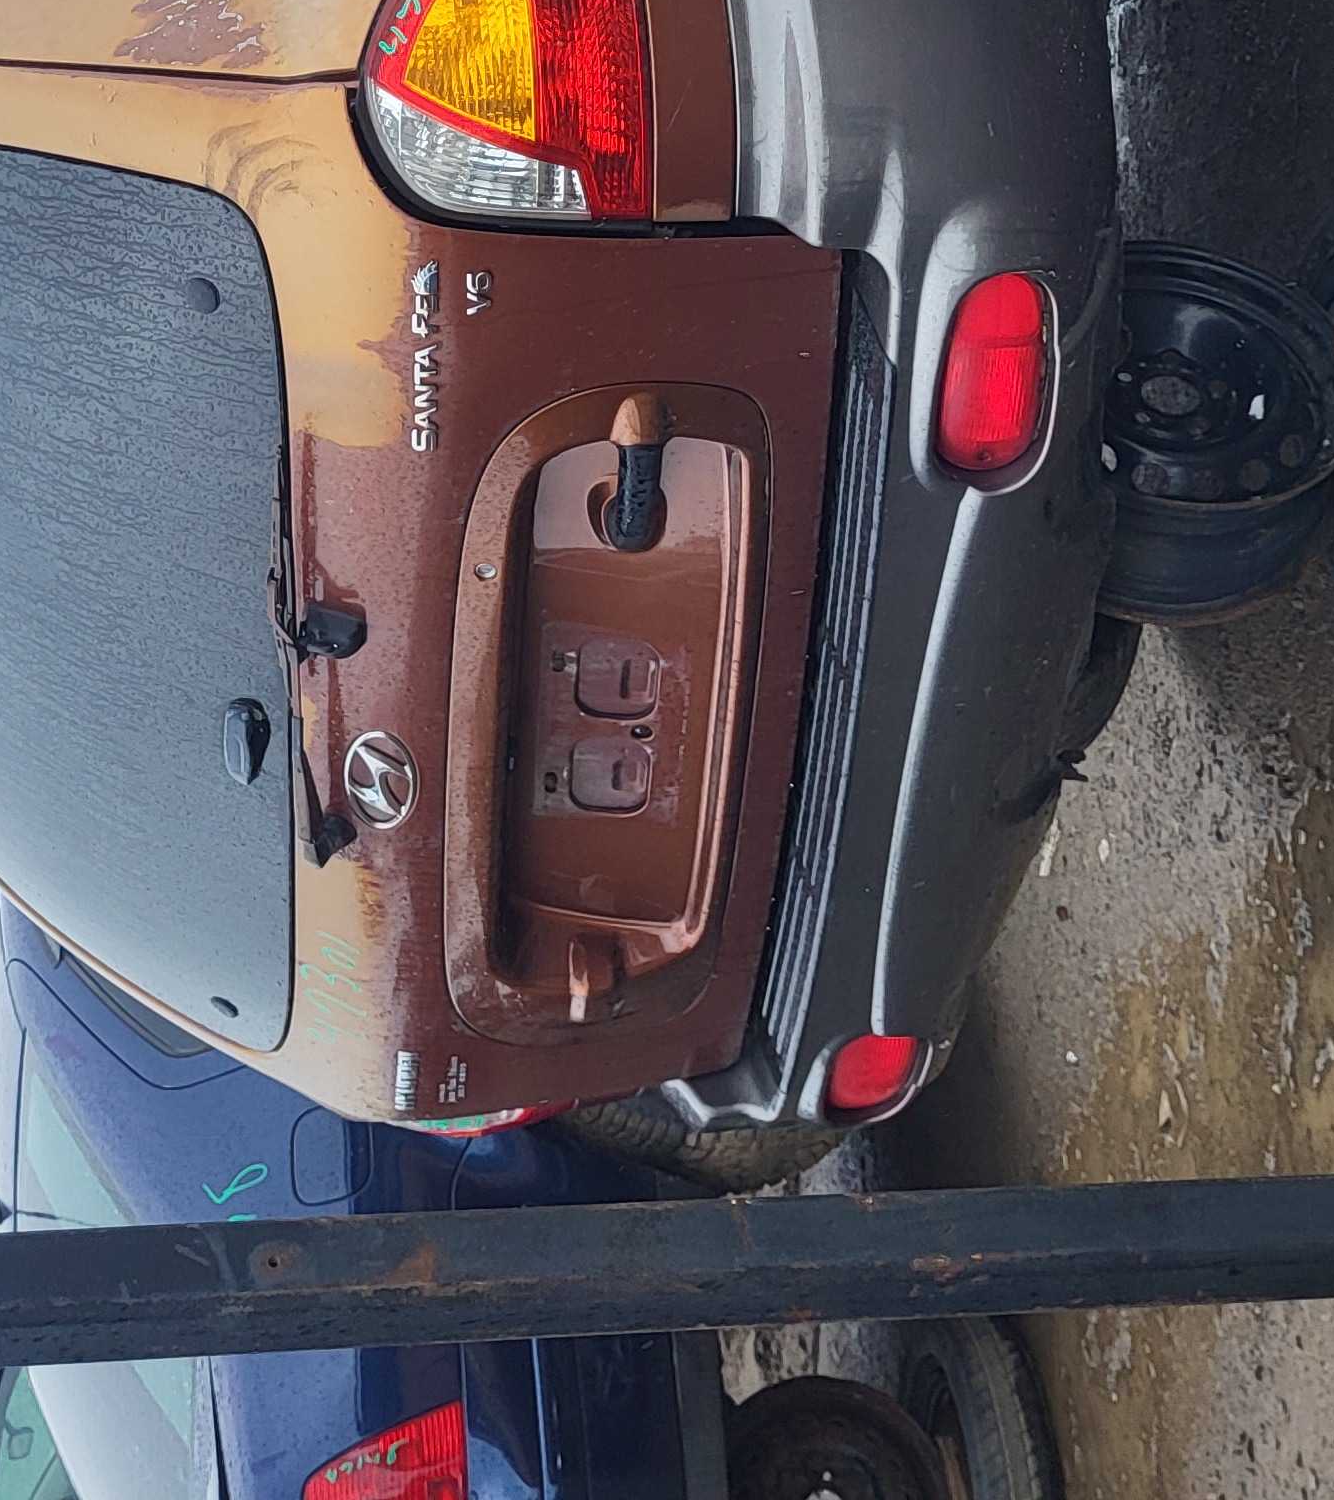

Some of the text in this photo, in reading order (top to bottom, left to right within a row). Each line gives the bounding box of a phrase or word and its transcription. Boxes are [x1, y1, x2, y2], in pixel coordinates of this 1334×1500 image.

[466, 271, 492, 315] V6
[411, 294, 438, 452] SANTA FE
